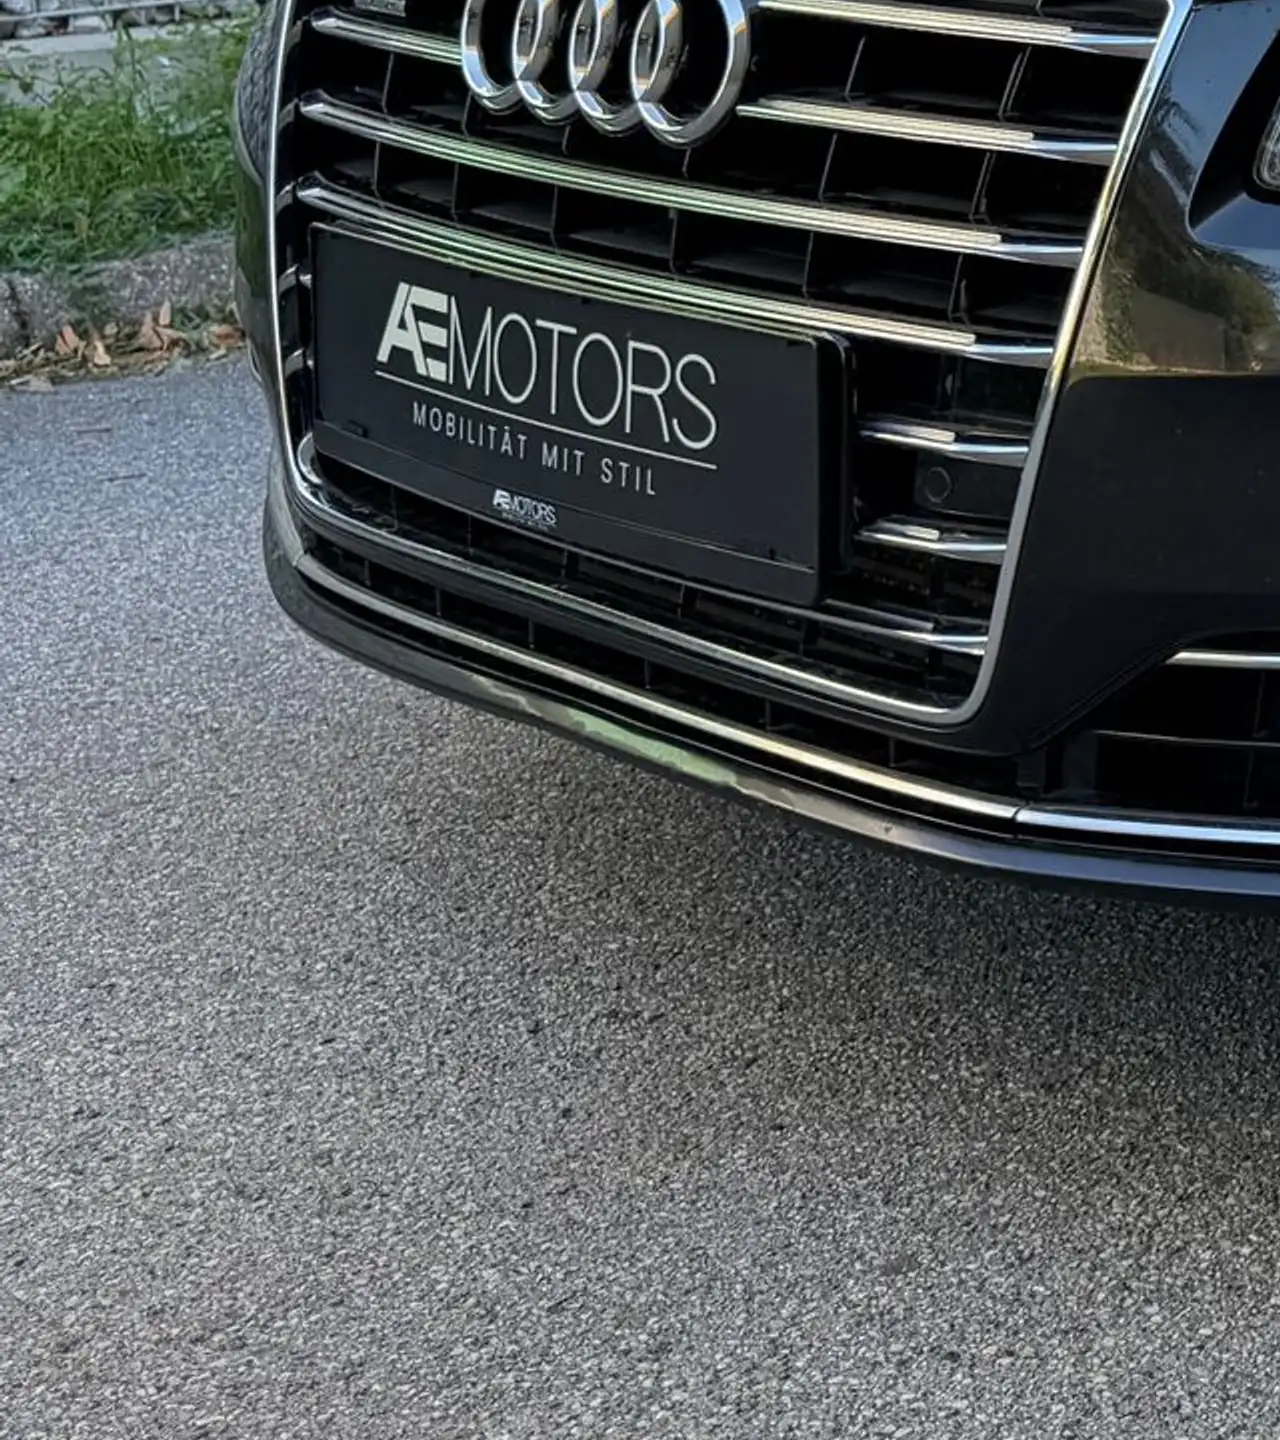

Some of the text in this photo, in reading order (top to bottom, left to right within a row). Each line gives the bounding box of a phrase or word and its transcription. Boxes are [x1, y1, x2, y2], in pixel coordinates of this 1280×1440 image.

[412, 401, 656, 496] MOBILITÄT MIT STIL
